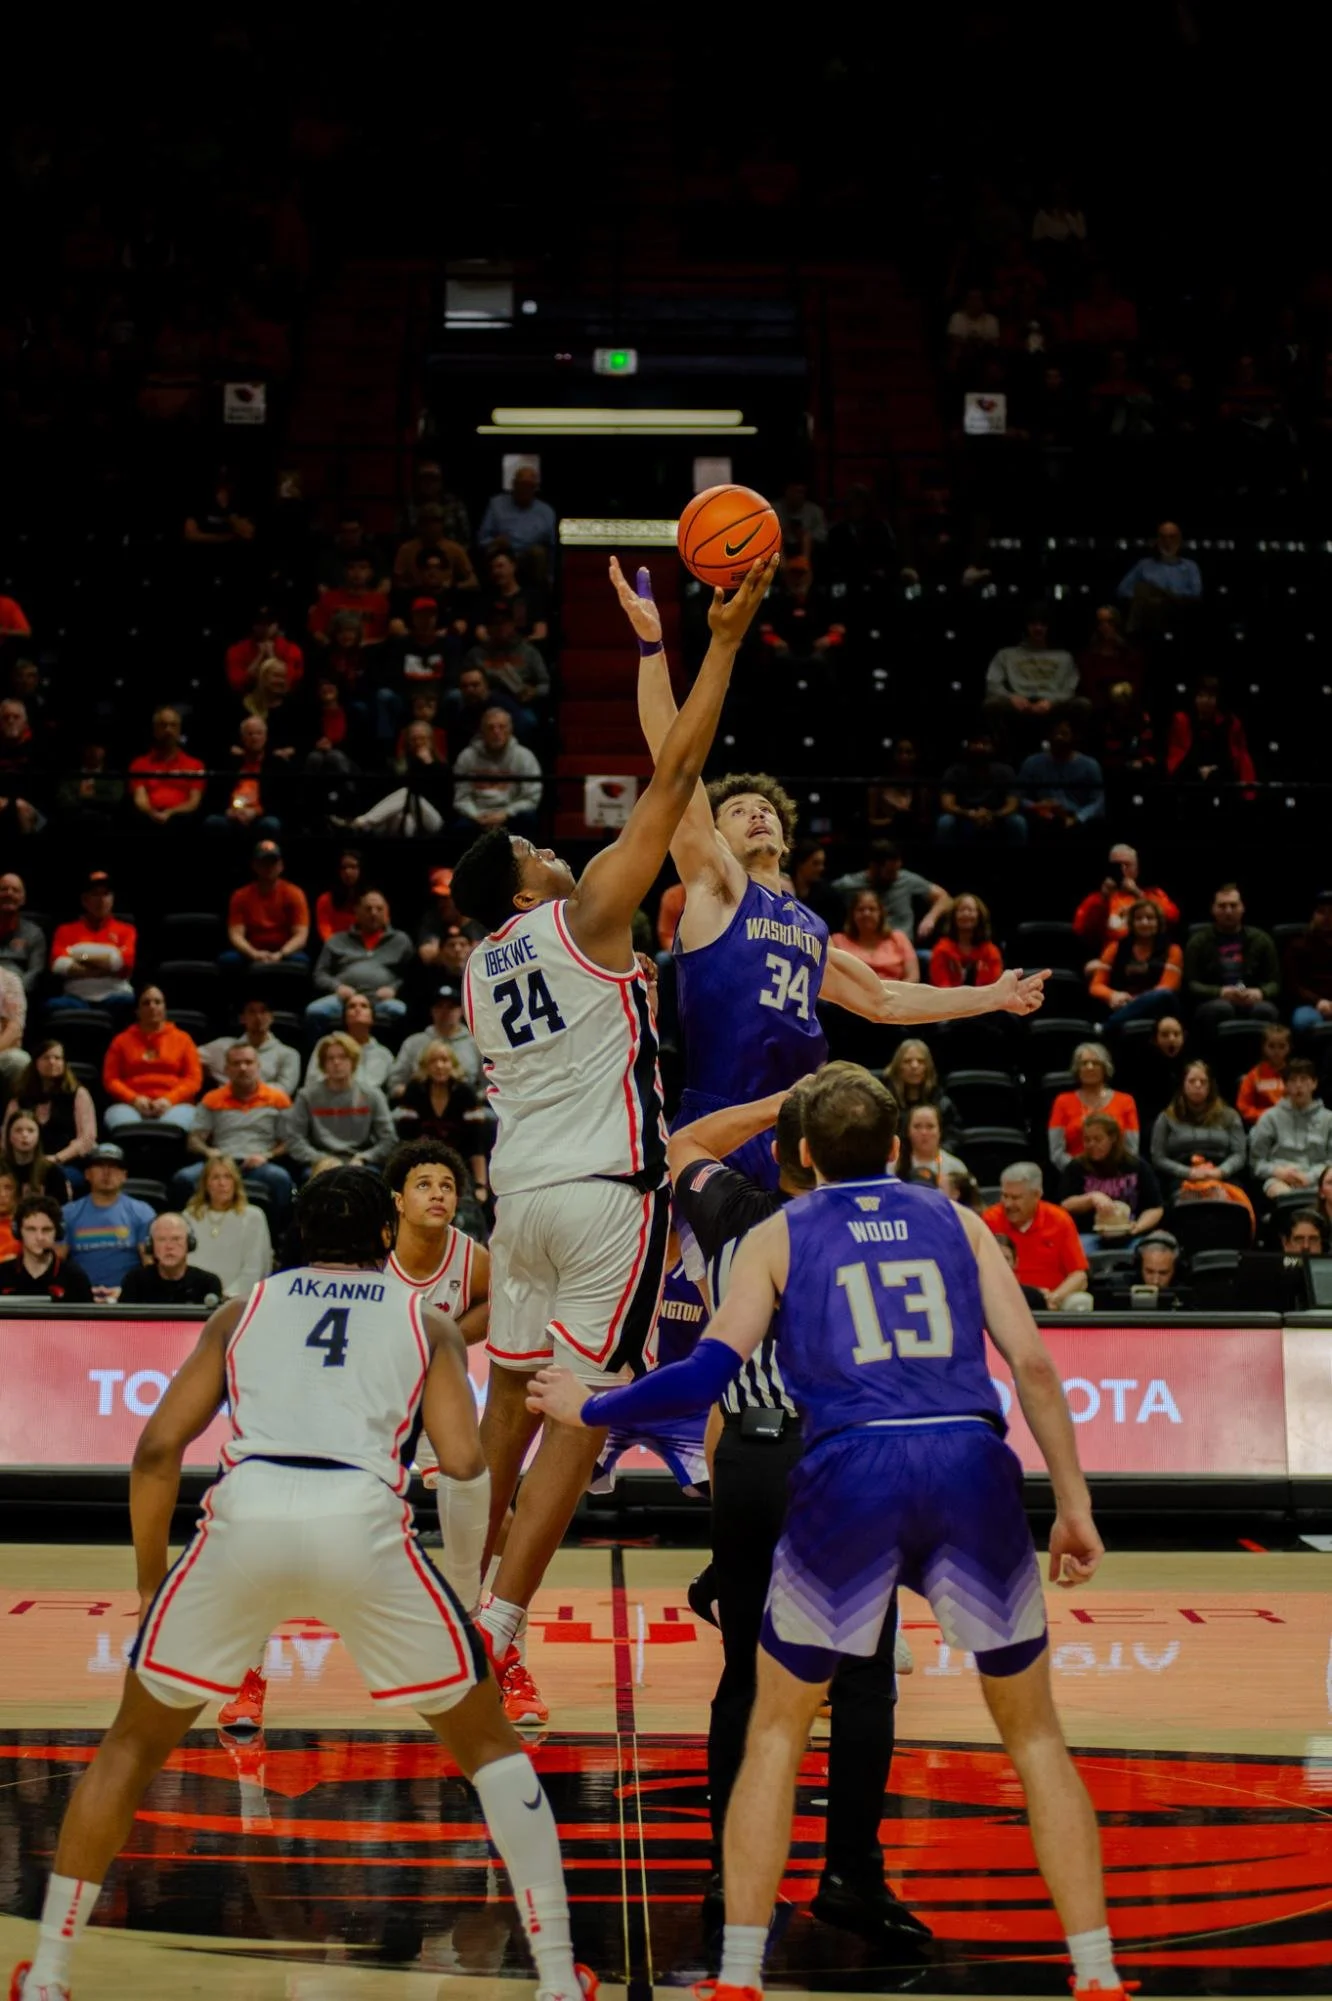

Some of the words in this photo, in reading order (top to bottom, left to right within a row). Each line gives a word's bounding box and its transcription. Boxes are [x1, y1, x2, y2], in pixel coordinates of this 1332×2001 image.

[485, 935, 538, 977] IBEKWE
[493, 969, 567, 1048] 24
[758, 952, 810, 1021] 34
[847, 1219, 909, 1243] WOOD
[288, 1277, 385, 1302] AKANNO
[660, 1299, 705, 1323] NGTON
[836, 1258, 955, 1366] 13
[305, 1307, 351, 1368] 4
[990, 1376, 1183, 1424] OTA
